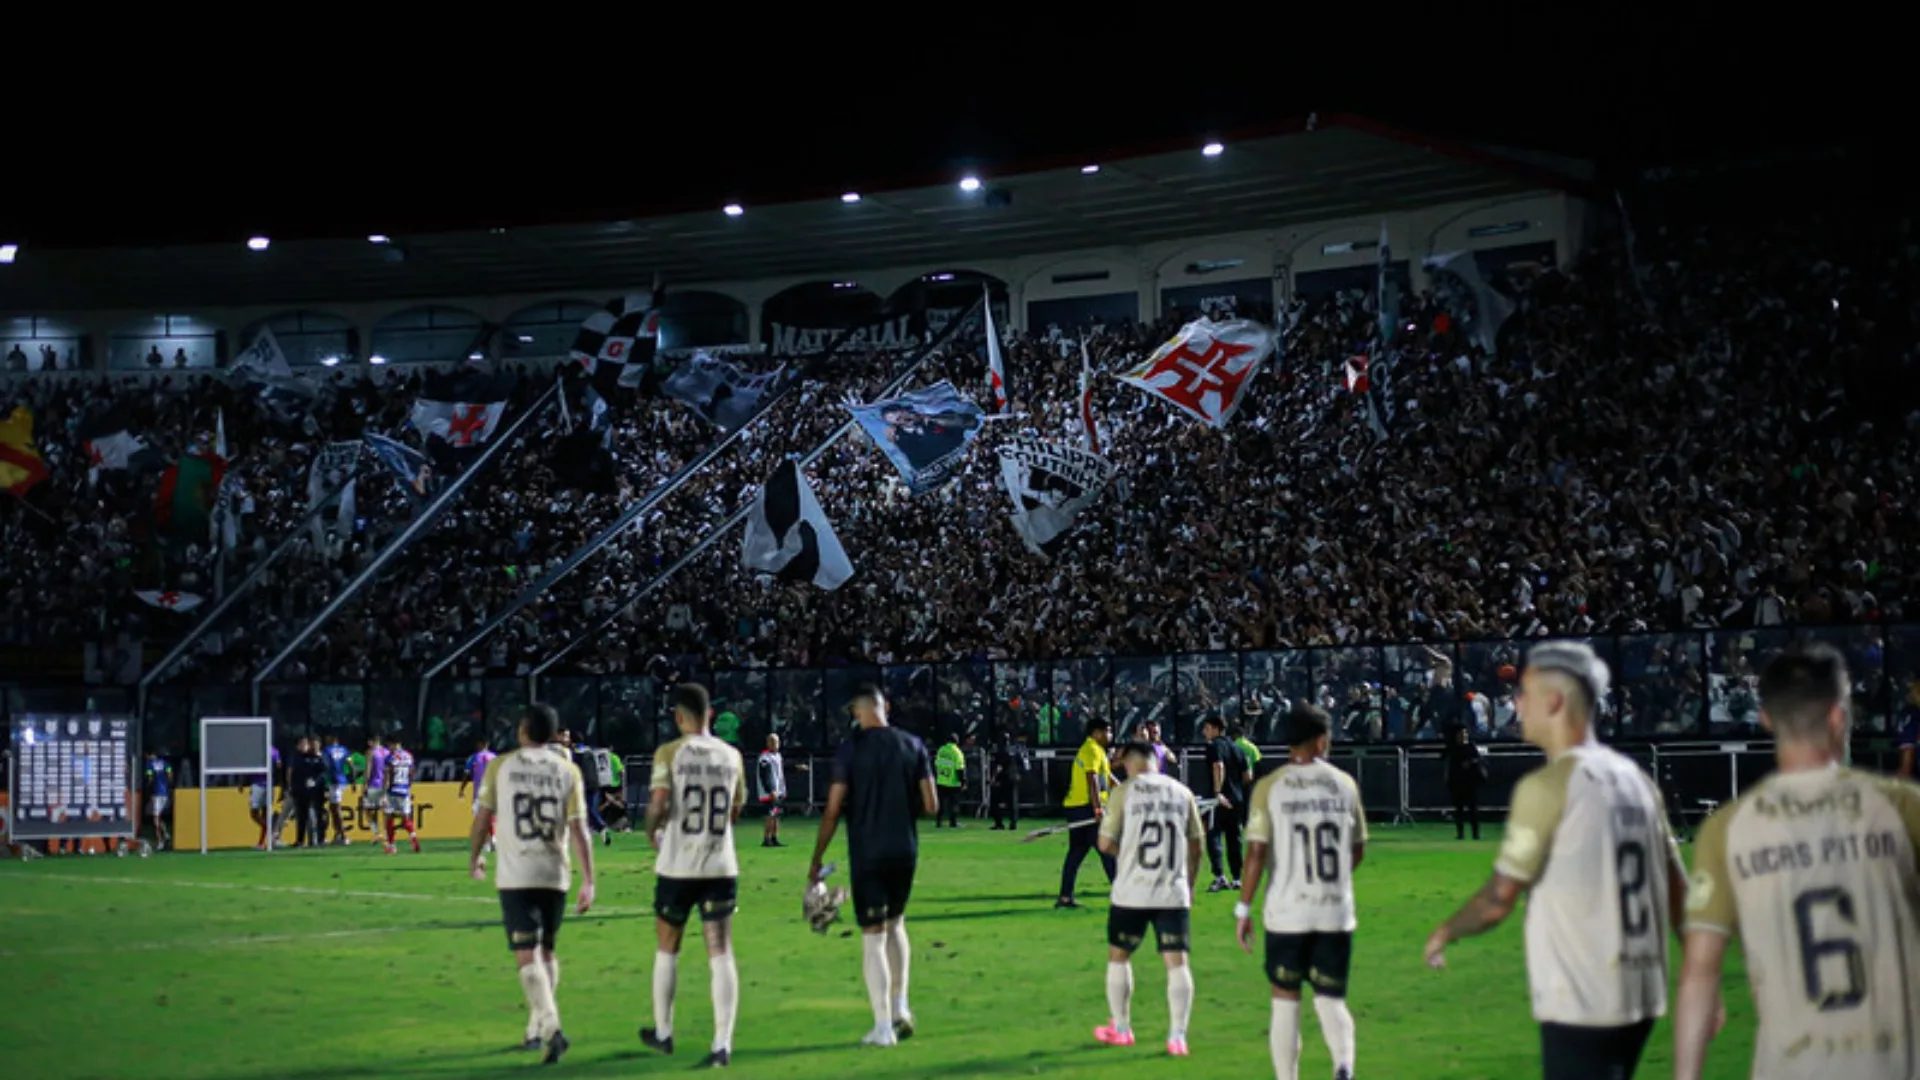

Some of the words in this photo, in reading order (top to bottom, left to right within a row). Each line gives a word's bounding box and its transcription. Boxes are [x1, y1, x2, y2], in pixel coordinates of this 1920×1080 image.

[514, 792, 559, 842] 85
[681, 784, 731, 836] 38
[1138, 819, 1177, 871] 21
[1293, 820, 1341, 884] 16
[1734, 841, 1814, 881] LUCAS
[1616, 841, 1650, 937] 2
[1795, 887, 1867, 1012] 6
